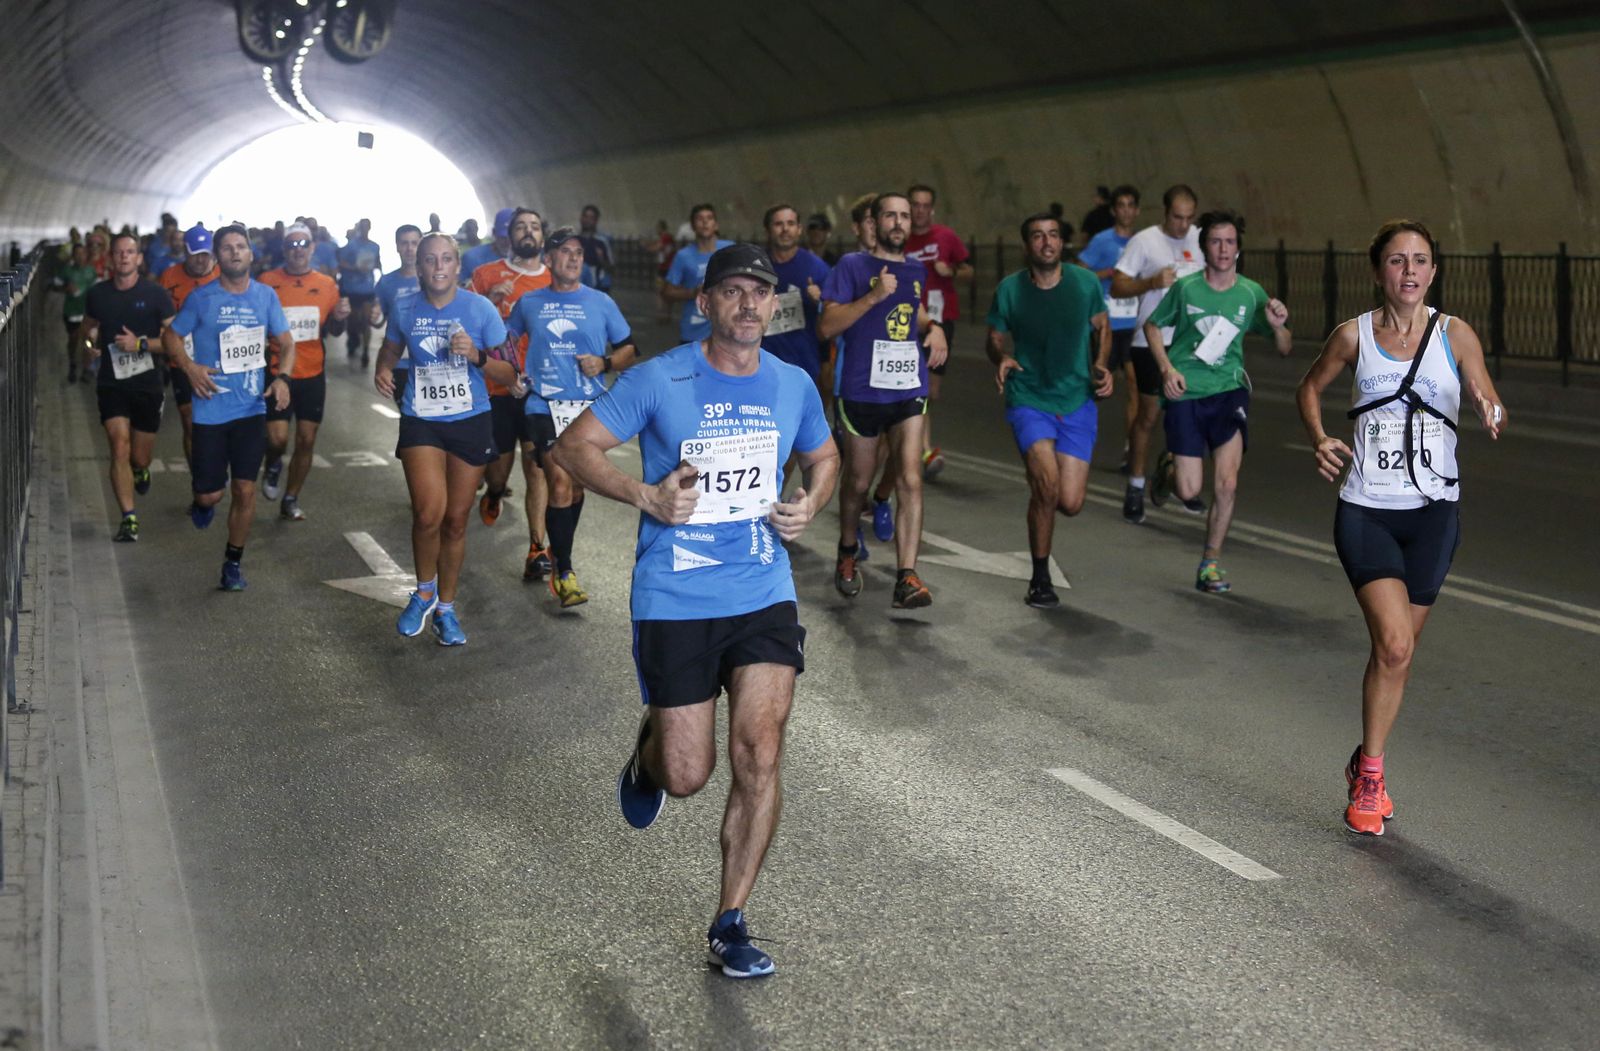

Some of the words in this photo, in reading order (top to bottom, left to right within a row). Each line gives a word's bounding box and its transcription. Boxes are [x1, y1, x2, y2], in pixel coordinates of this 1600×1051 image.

[225, 343, 261, 359] 18902
[878, 360, 916, 373] 15955
[421, 384, 466, 399] 18516
[703, 402, 732, 418] 39º
[700, 419, 740, 428] CARRERA
[743, 419, 776, 428] URBANA
[697, 428, 730, 437] CIUDAD
[685, 441, 711, 455] 39º
[715, 438, 745, 446] CARRERA
[747, 434, 773, 442] URBANA
[713, 447, 737, 455] CIUDAD
[749, 442, 775, 450] MÁLAGA
[698, 466, 761, 493] 1572
